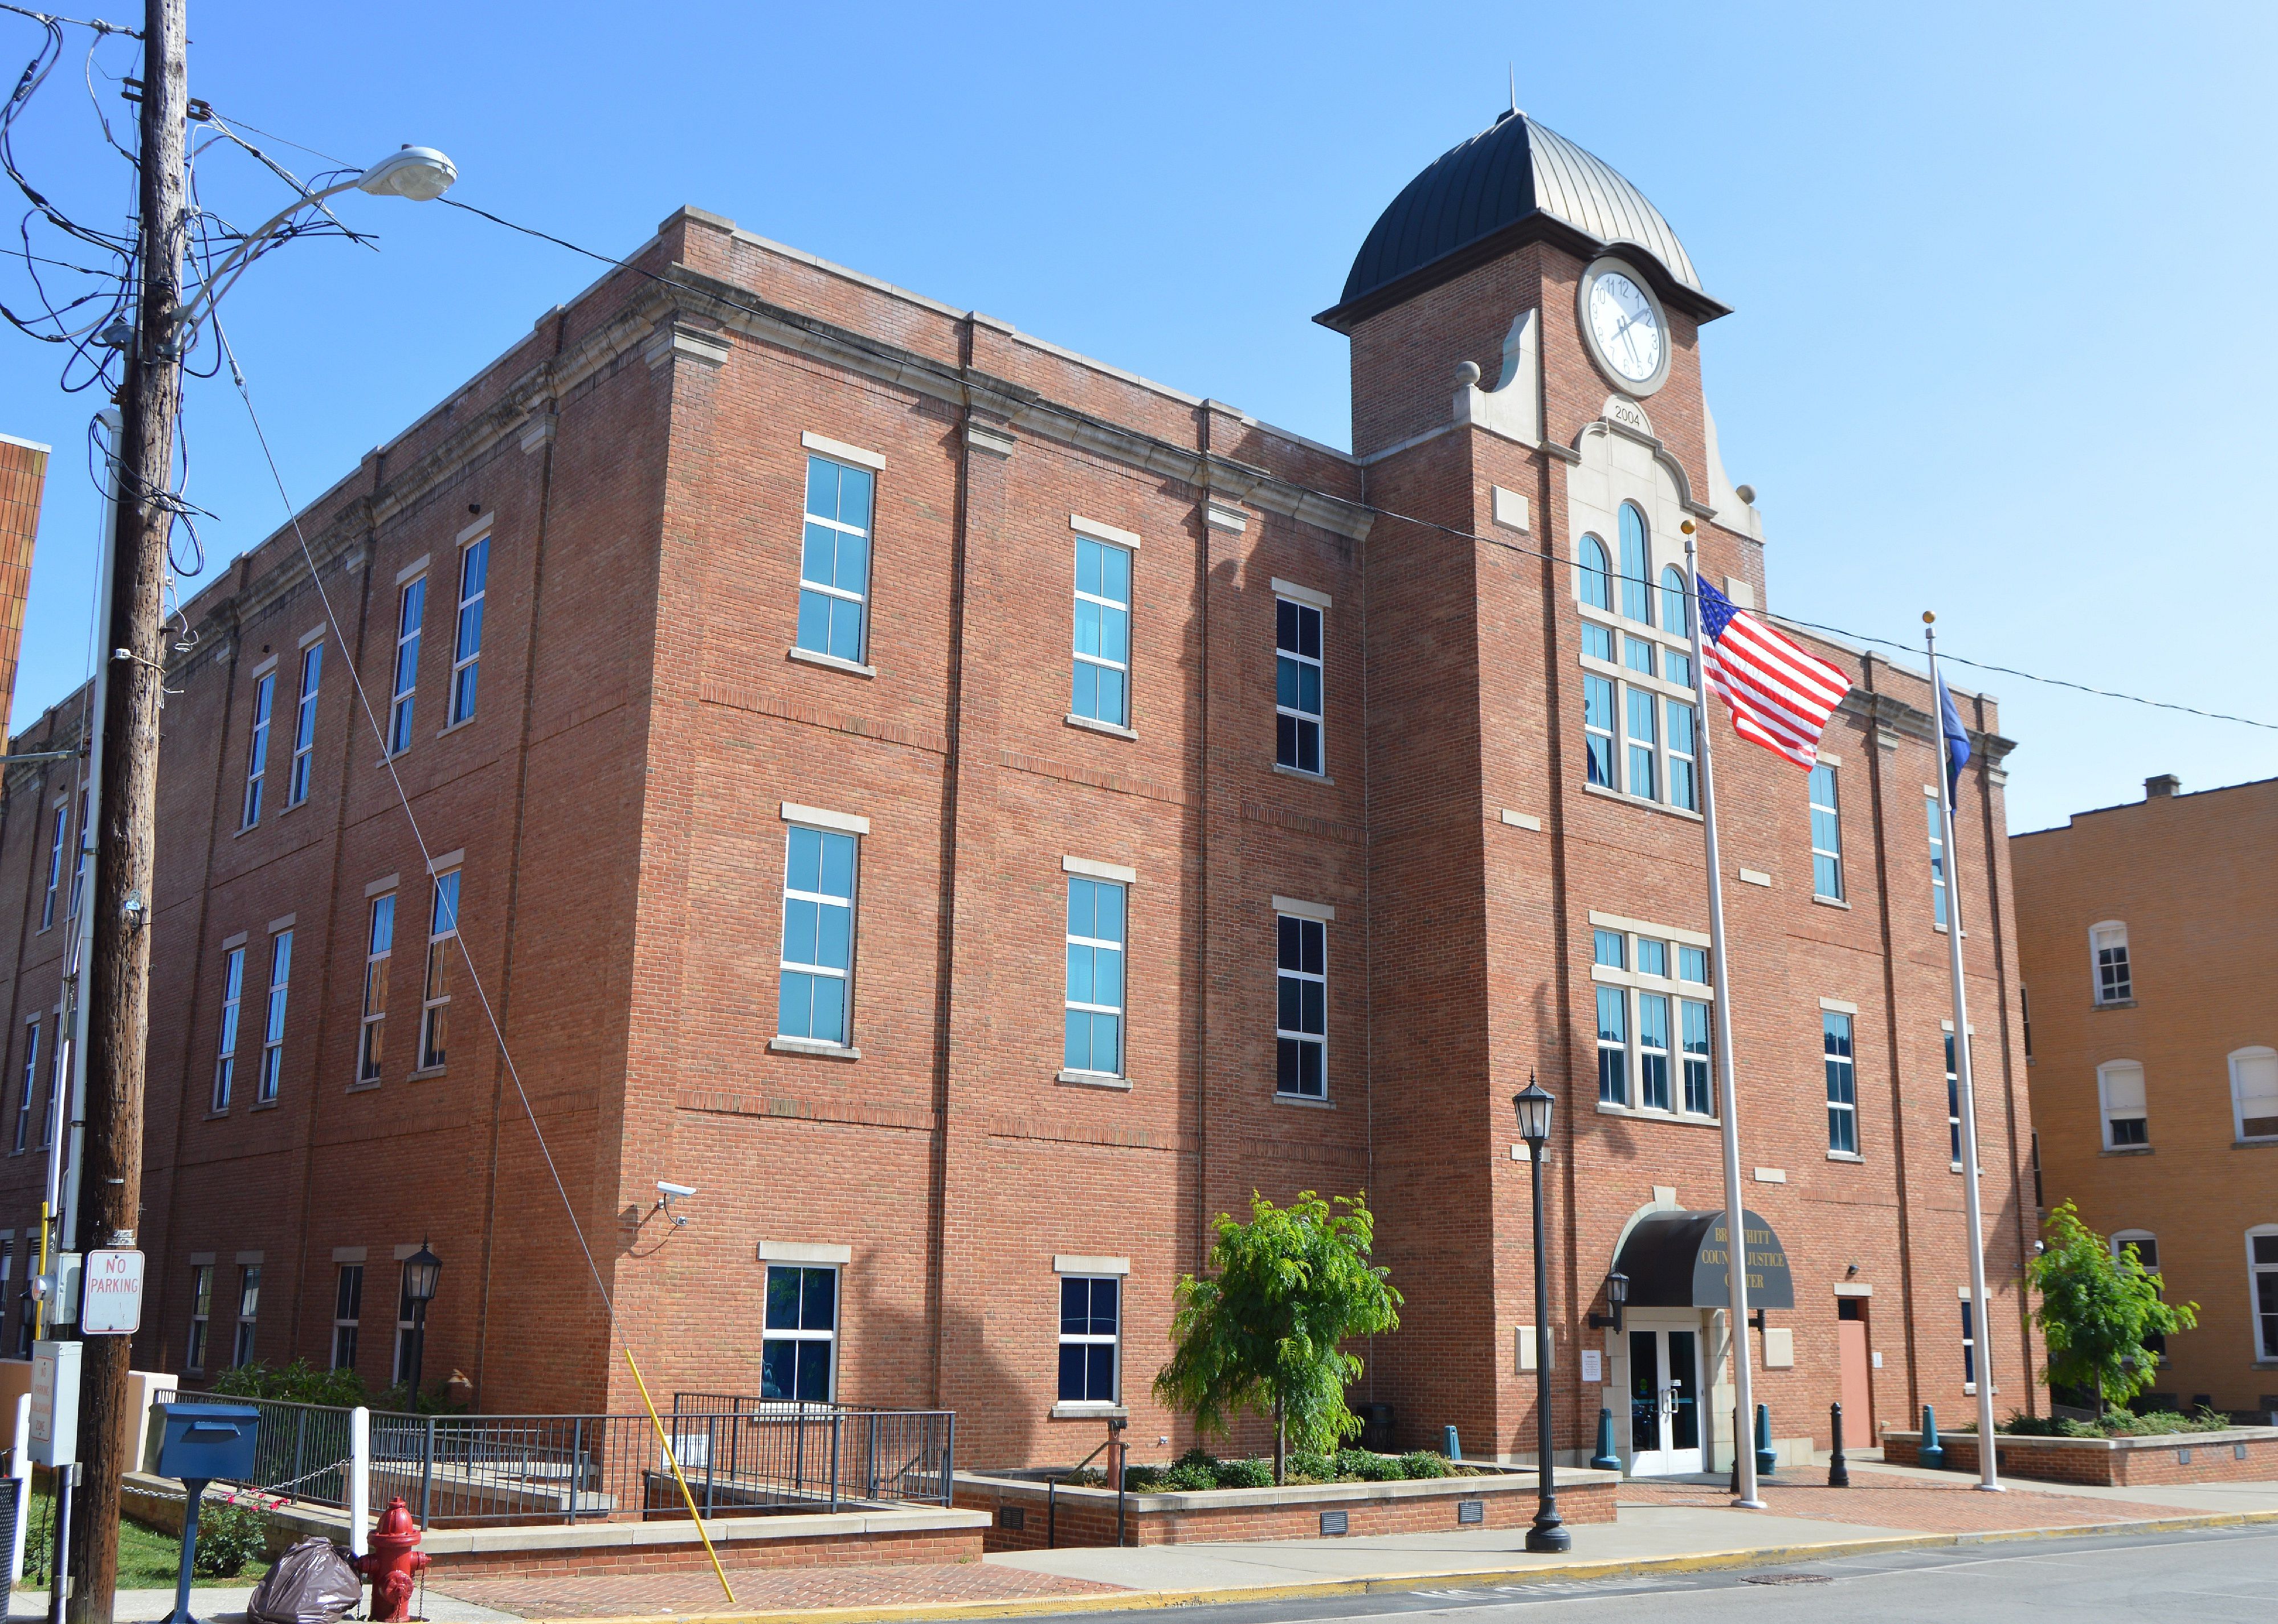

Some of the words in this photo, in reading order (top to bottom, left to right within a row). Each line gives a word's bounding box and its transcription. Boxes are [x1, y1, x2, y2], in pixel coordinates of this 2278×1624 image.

[1606, 276, 1614, 296] 11
[1618, 279, 1628, 299] 12
[1595, 285, 1605, 304] 10
[1635, 292, 1640, 309] 1
[1592, 303, 1598, 320] 9
[1646, 312, 1652, 328] 2
[1598, 327, 1604, 342] 8
[1652, 334, 1658, 350] 3
[1610, 346, 1615, 362] 7
[1647, 352, 1654, 368] 4
[1623, 359, 1630, 375] 6
[1637, 360, 1644, 377] 5
[1615, 405, 1639, 427] 2004
[1715, 1227, 1770, 1244] BRHITT
[106, 1258, 126, 1274] NO
[1702, 1250, 1729, 1264] COUN
[1748, 1252, 1785, 1267] JUSTICE
[90, 1278, 138, 1294] PARKING
[1724, 1272, 1764, 1288] CTER
[40, 1366, 47, 1377] NO
[36, 1419, 45, 1432] ZONE
